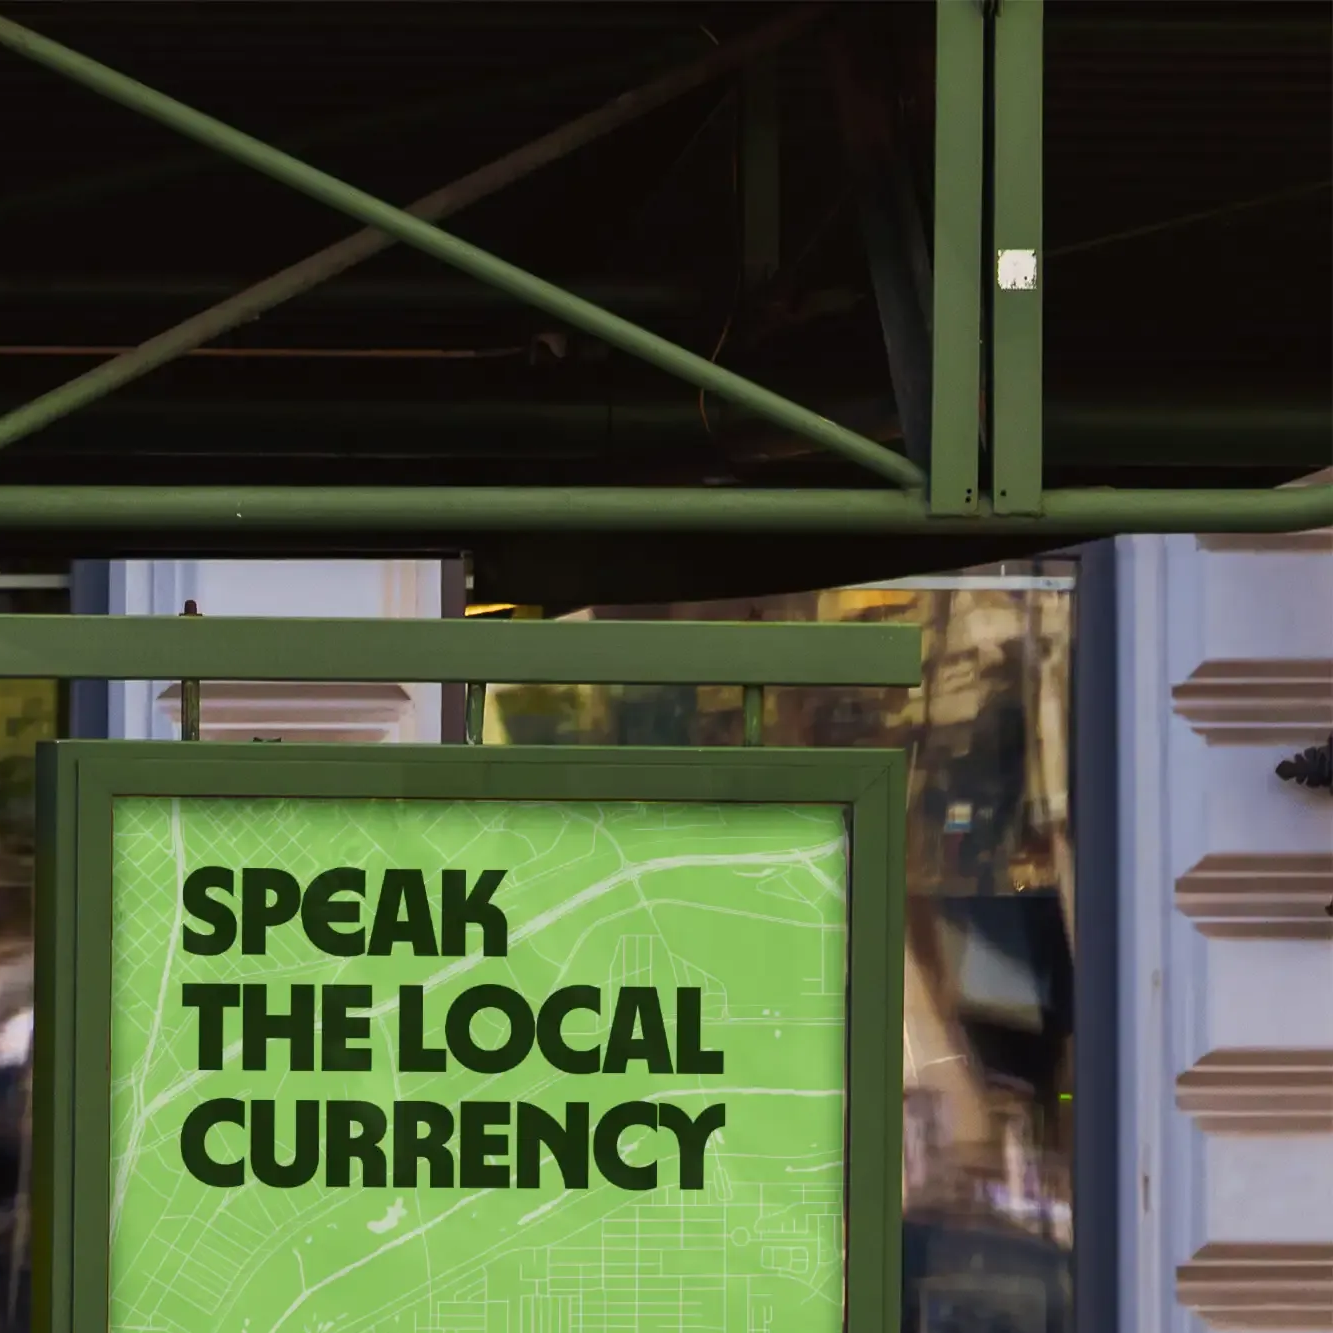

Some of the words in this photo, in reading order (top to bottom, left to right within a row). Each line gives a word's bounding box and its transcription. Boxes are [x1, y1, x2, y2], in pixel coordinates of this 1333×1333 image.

[182, 866, 508, 957] SPEAK
[181, 983, 373, 1072] THE
[398, 983, 725, 1075] LOCAL
[180, 1097, 726, 1191] CURRENCY
